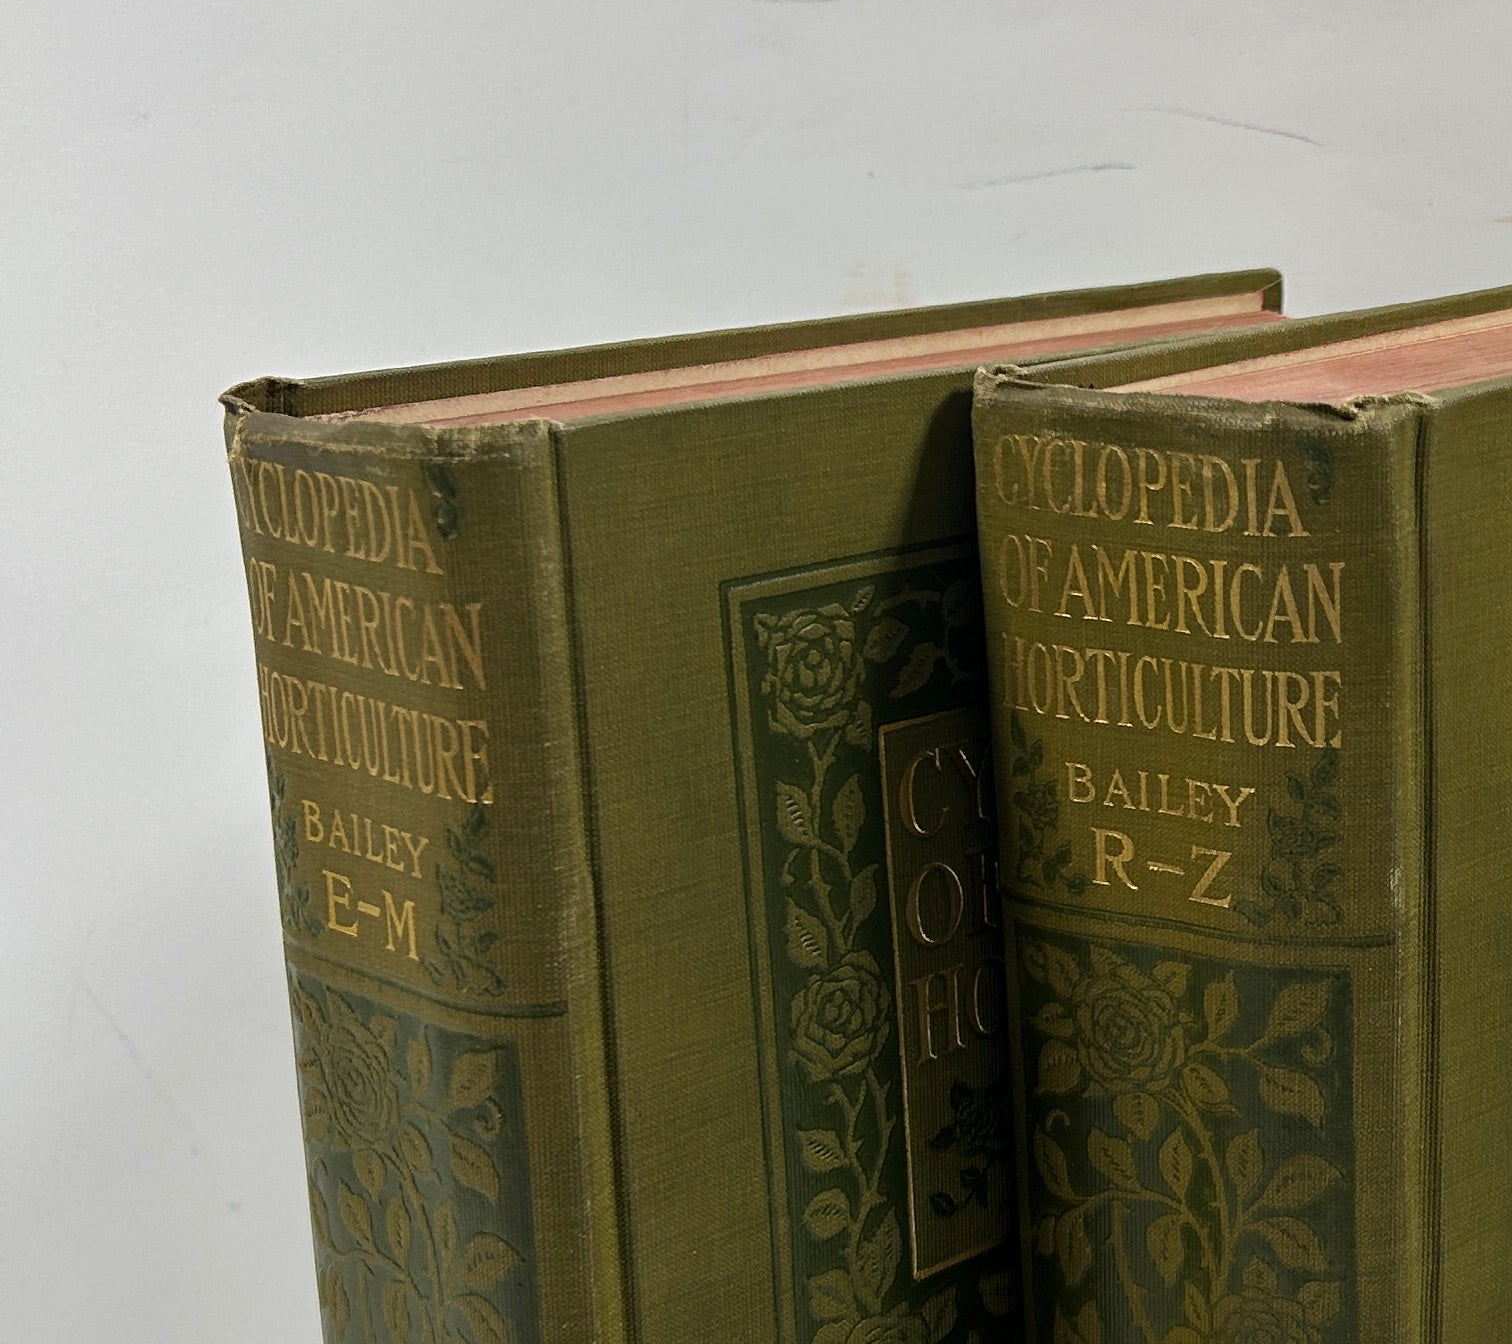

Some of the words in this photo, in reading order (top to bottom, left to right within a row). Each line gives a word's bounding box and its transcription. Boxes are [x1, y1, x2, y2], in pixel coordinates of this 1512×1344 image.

[239, 457, 445, 576] YCLOPEDIA
[992, 433, 1311, 538] CYCLOPEDIA
[282, 569, 487, 691] AMERICAN
[1000, 534, 1053, 613] OF
[1054, 543, 1346, 644] AMERICAN
[258, 663, 495, 807] HORTICULTURE
[1001, 631, 1344, 751] HORTICULTURE
[301, 799, 430, 879] BAILEY
[1064, 761, 1257, 829] BAILEY
